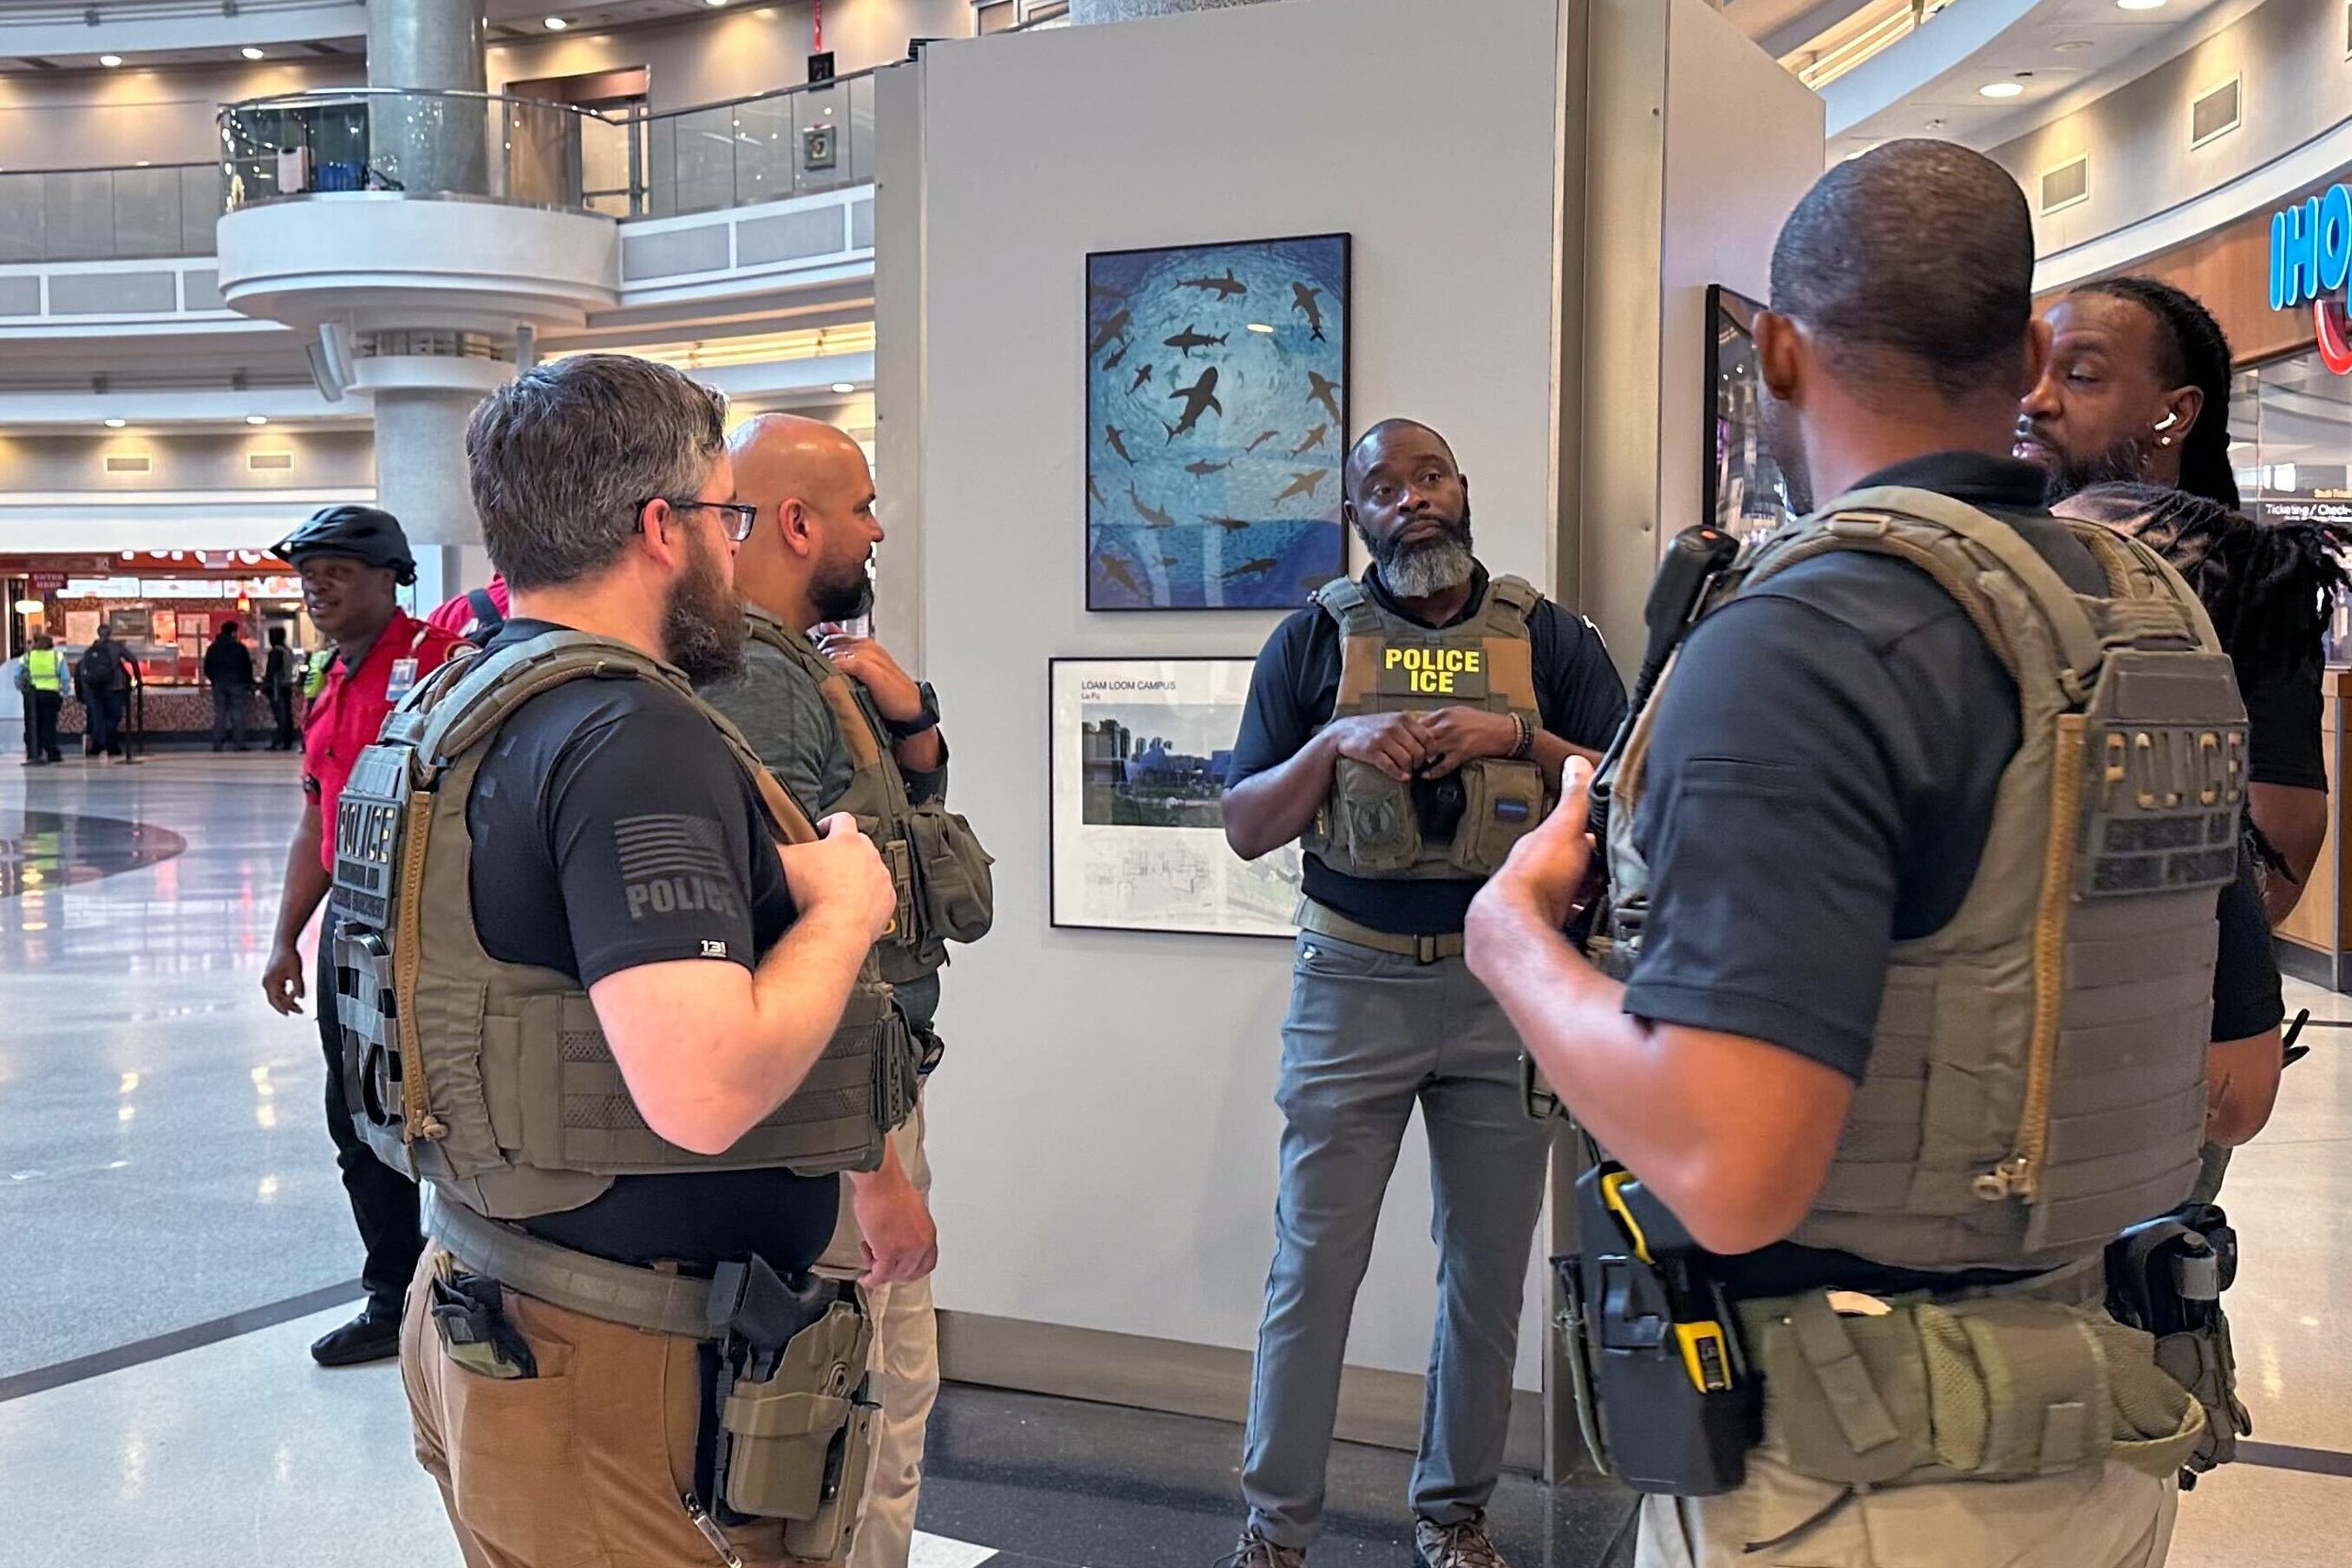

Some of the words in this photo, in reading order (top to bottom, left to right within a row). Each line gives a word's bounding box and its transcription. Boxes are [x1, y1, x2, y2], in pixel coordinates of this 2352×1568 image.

[2270, 183, 2352, 319] IHO
[2265, 504, 2310, 517] Ticketing
[1385, 649, 1480, 673] POLICE
[1081, 681, 1107, 690] LOAM
[1109, 681, 1135, 690] LOOM
[1137, 681, 1176, 690] CAMPUS
[1410, 670, 1454, 693] ICE
[2104, 730, 2244, 812] POLICE
[336, 800, 396, 864] POLICE
